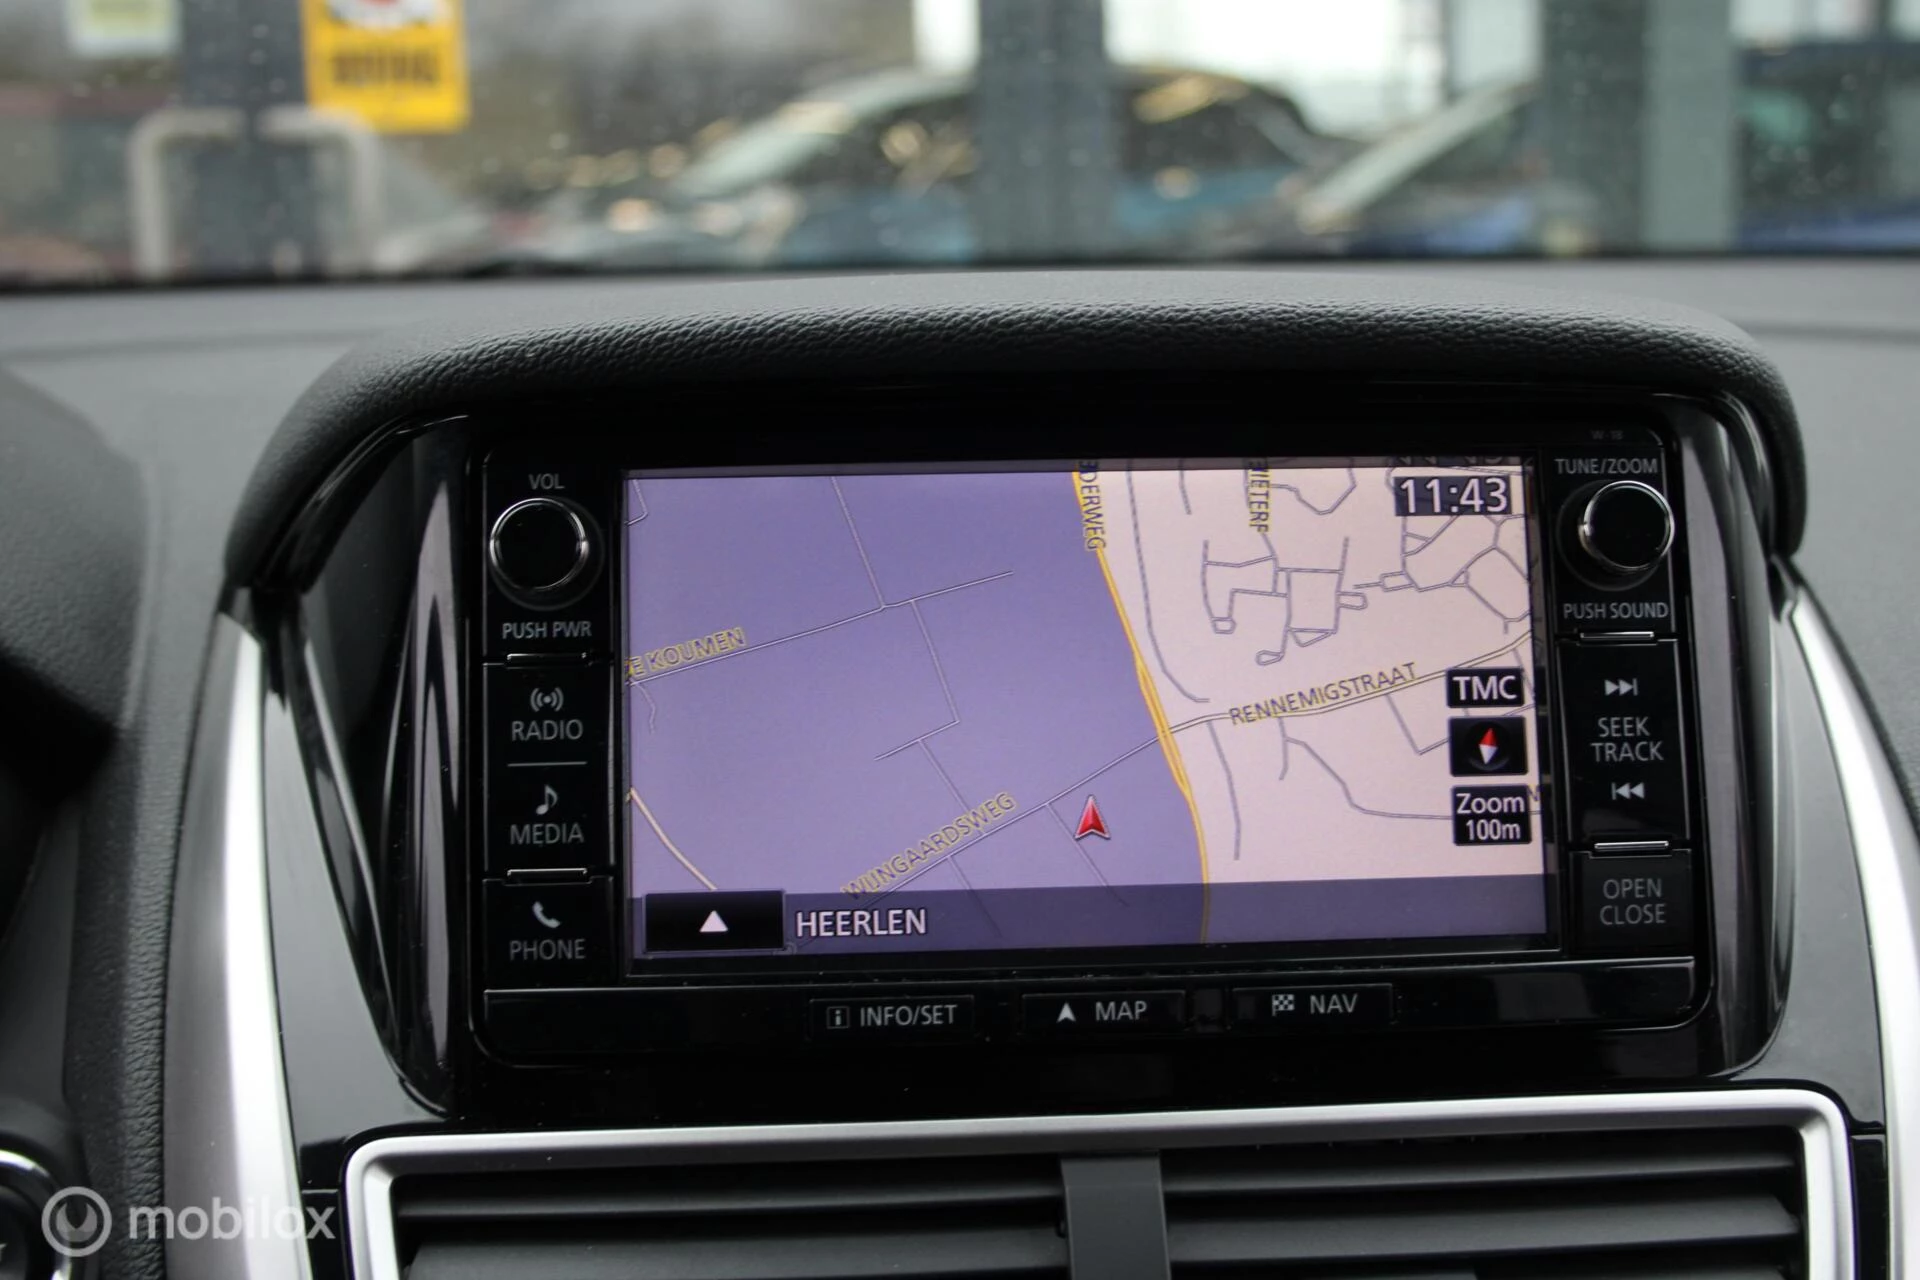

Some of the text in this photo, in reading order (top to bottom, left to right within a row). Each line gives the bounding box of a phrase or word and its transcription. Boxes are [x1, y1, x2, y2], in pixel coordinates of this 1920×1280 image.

[1554, 457, 1658, 475] TUNE/ZOOM
[528, 473, 565, 490] VOL
[1400, 477, 1508, 513] 11:43
[1563, 602, 1669, 620] PUSH SOUND
[502, 621, 592, 639] PUSH PWR
[646, 626, 747, 672] KOUMEN
[1229, 661, 1417, 725] RENNEMIGSTRAAT
[1453, 675, 1517, 700] TMC
[510, 719, 584, 741] RADIO
[1597, 717, 1650, 737] SEEK
[1590, 741, 1664, 762] TRACK
[1456, 792, 1525, 814] Zoom
[509, 823, 585, 845] MEDIA
[1465, 819, 1521, 841] 100m
[1602, 878, 1662, 899] OPEN
[796, 909, 927, 937] HEERLEN
[1599, 903, 1666, 925] CLOSE
[509, 938, 586, 961] PHONE
[1095, 1001, 1147, 1021] MAP
[1309, 994, 1357, 1014] NAV
[859, 1004, 957, 1027] INFO/SET
